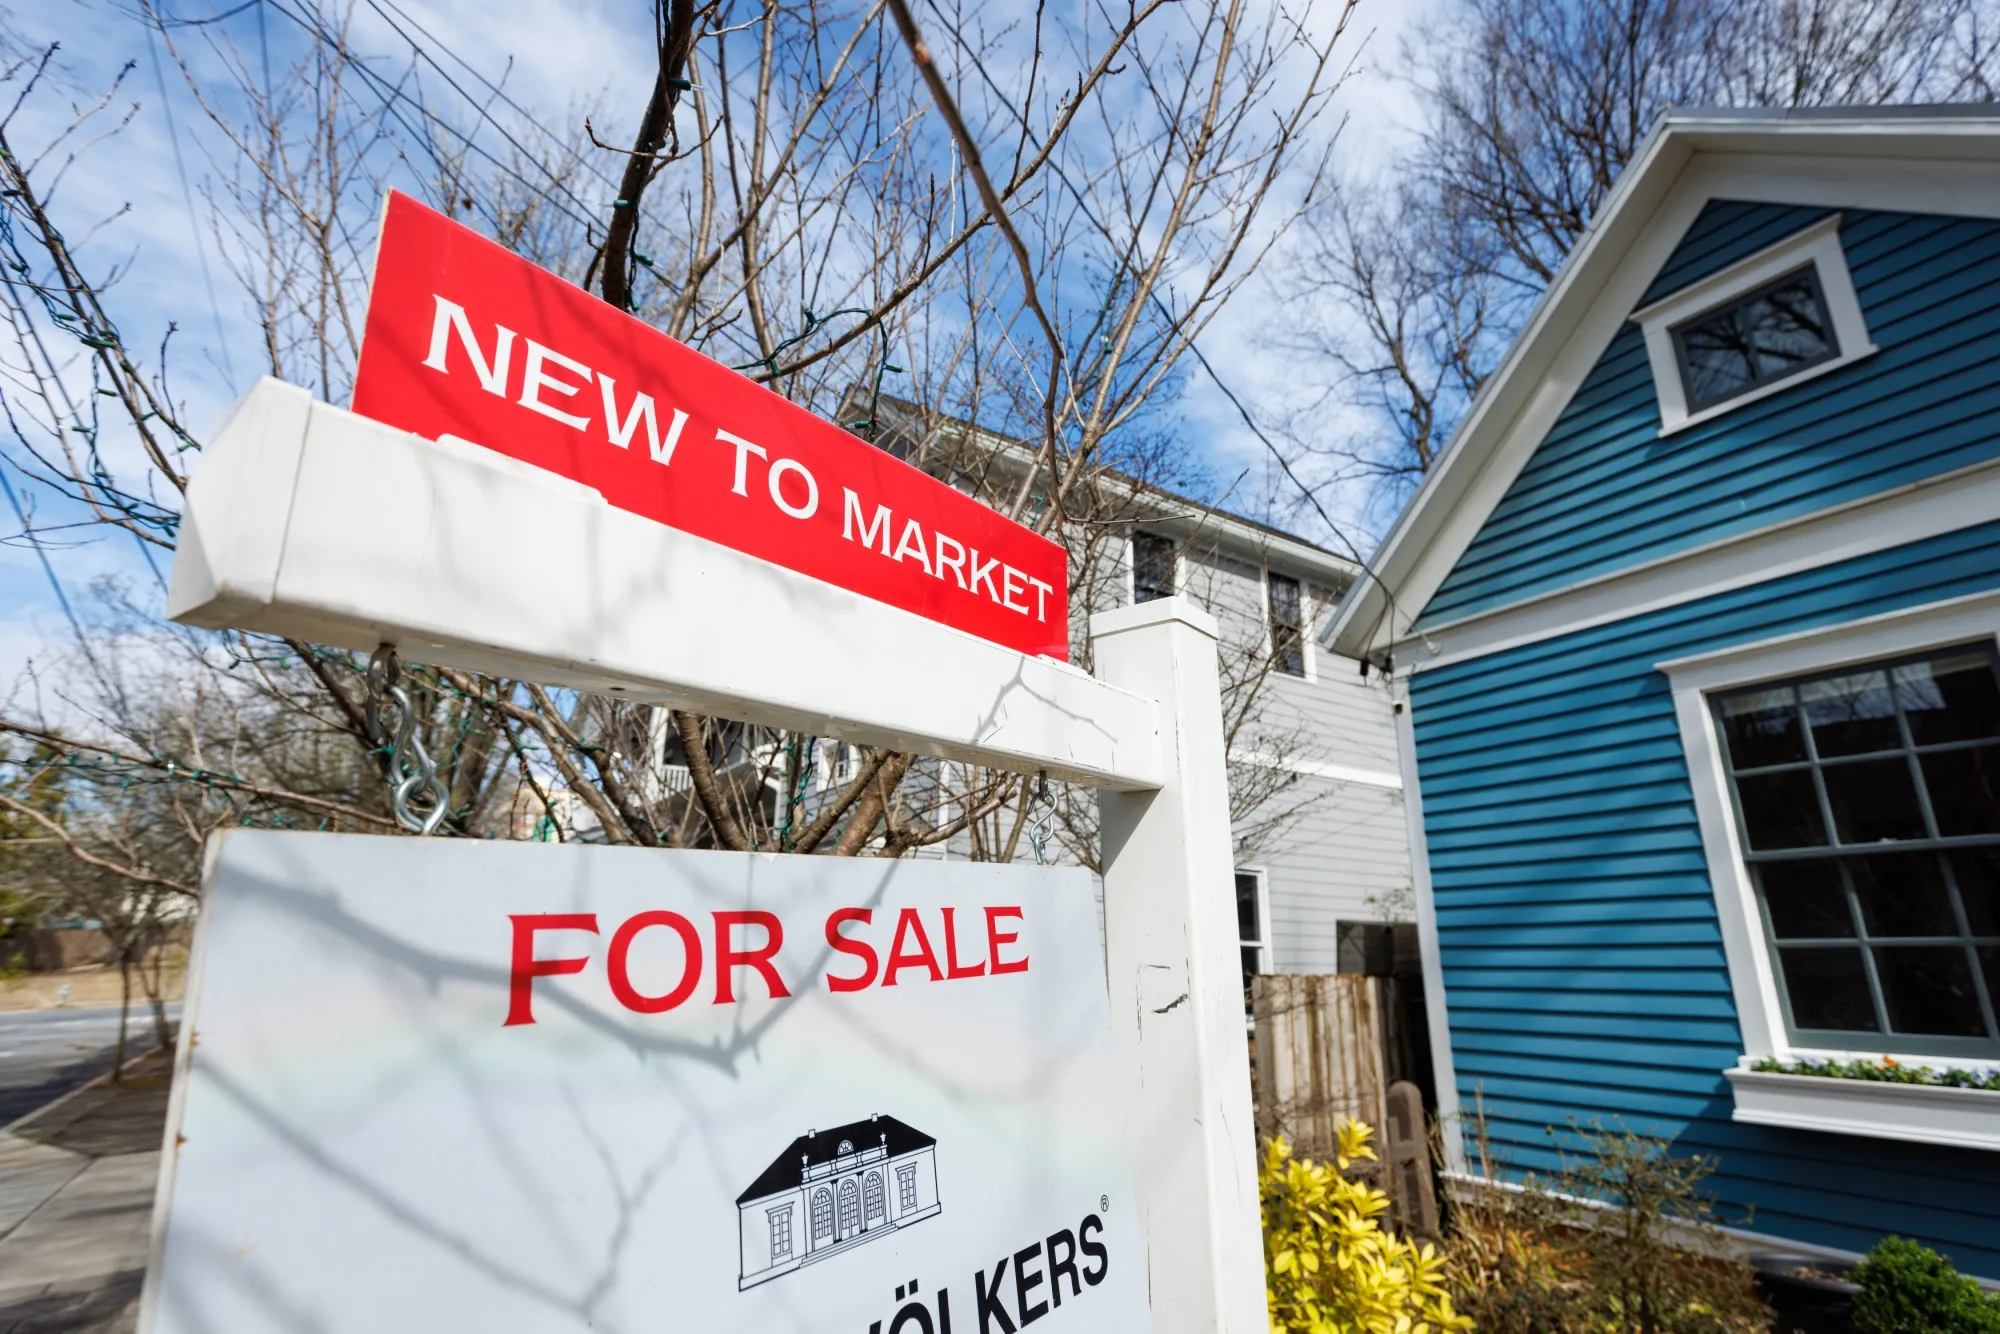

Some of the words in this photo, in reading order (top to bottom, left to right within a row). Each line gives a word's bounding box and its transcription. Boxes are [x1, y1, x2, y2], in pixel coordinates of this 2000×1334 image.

[422, 294, 690, 466] NEW
[715, 428, 819, 520] TO
[842, 487, 1053, 623] MARKET
[504, 909, 790, 1027] FOR
[824, 905, 1029, 993] SALE
